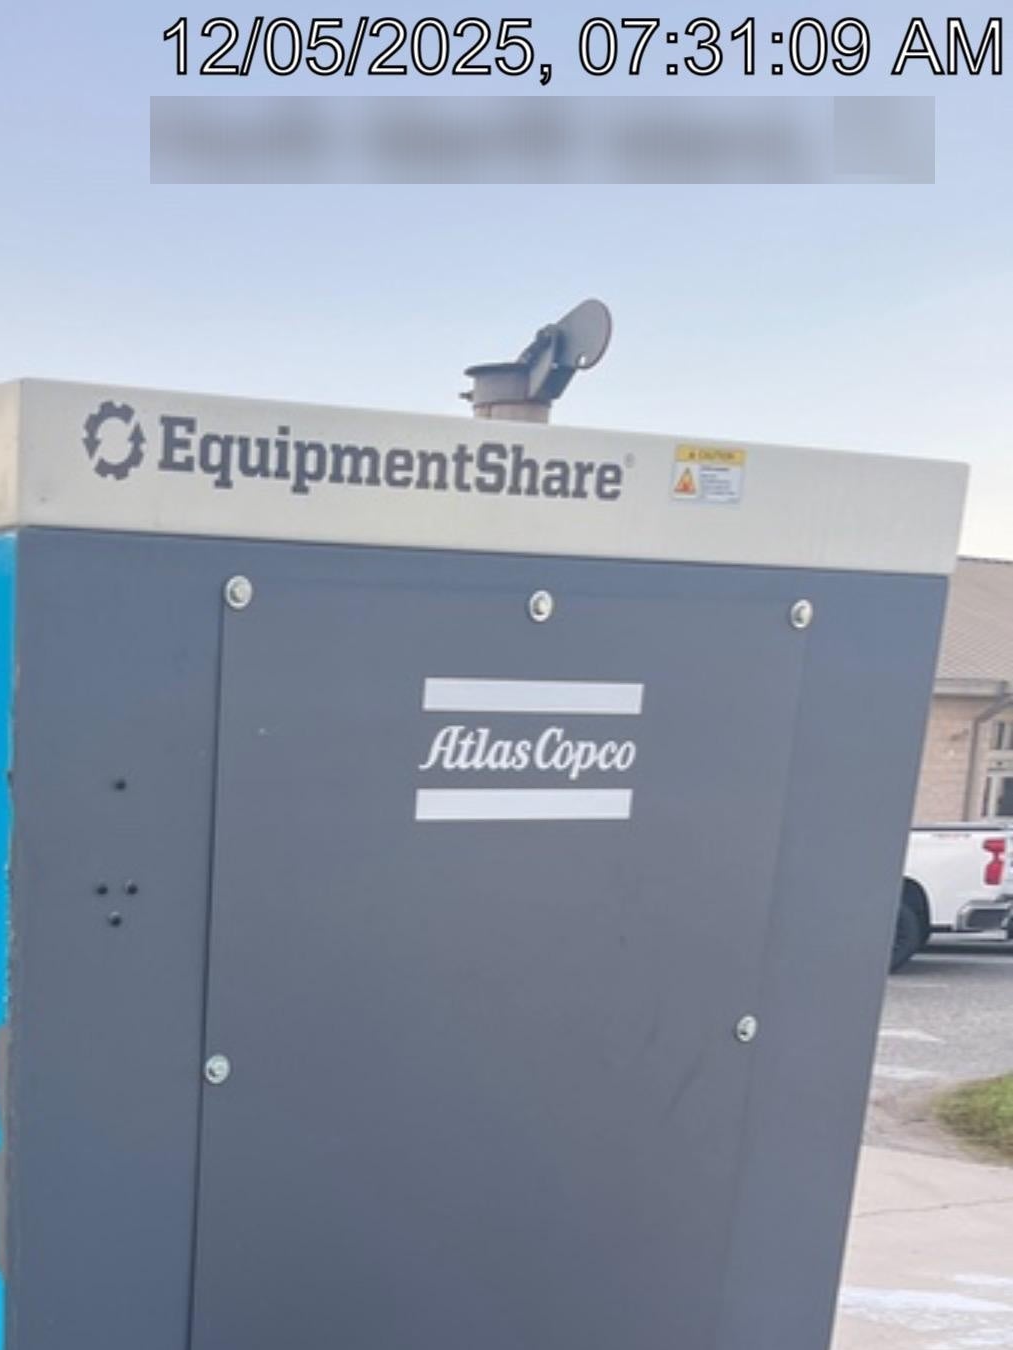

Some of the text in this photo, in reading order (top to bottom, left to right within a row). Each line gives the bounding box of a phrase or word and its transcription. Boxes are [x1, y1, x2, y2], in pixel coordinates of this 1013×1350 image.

[158, 415, 623, 501] EquipmentShare
[418, 725, 637, 781] Atlas Copco
